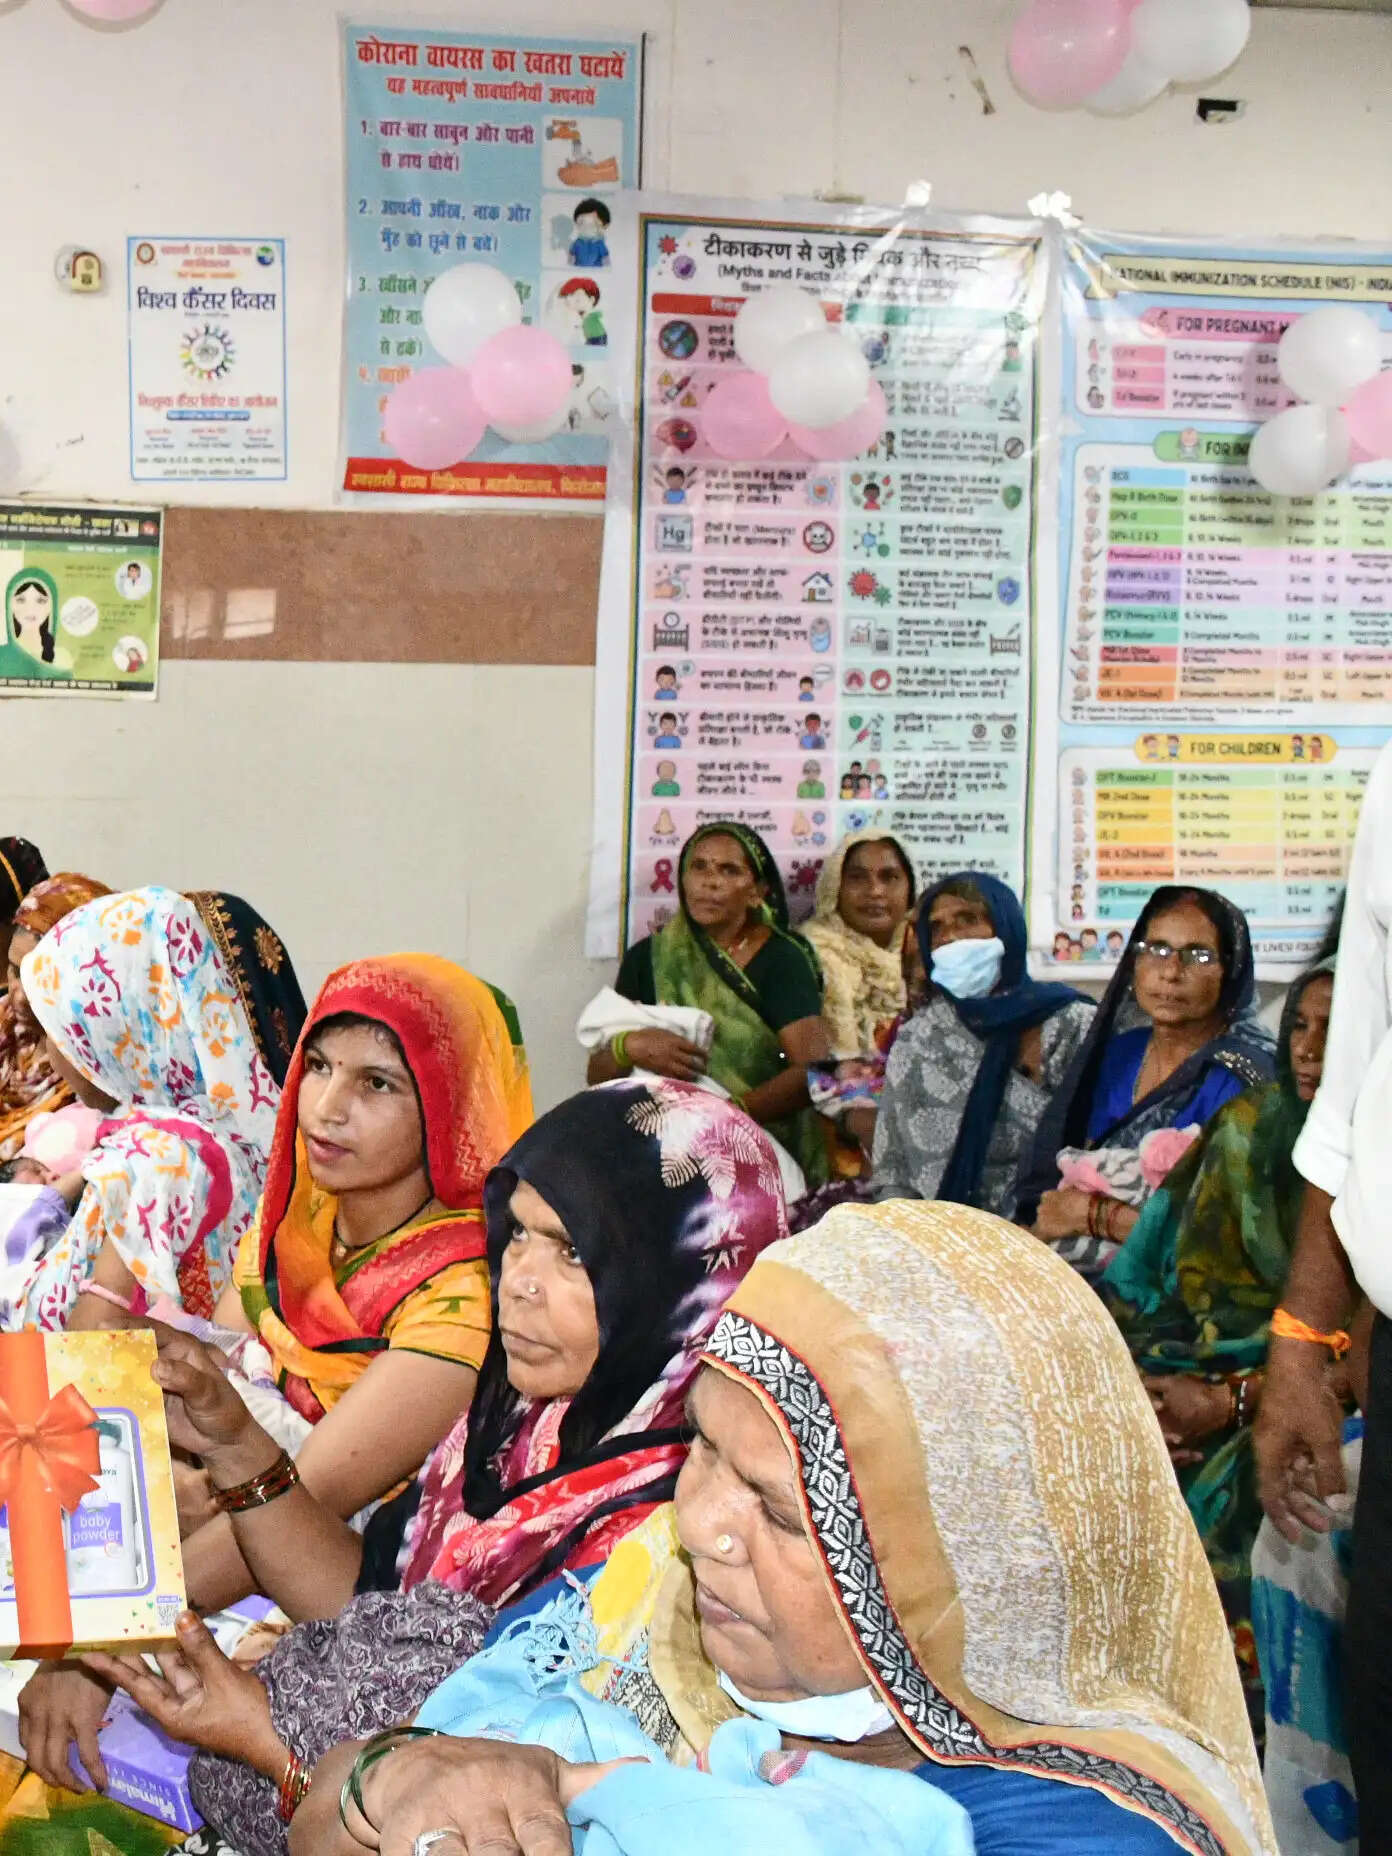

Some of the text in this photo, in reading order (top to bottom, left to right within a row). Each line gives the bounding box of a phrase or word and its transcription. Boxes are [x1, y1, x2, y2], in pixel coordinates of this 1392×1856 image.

[426, 45, 484, 71] वायरस
[492, 50, 516, 73] का
[524, 52, 572, 76] खतरा
[434, 123, 469, 145] साबुन
[475, 123, 500, 143] और
[505, 124, 536, 144] पानी
[507, 202, 531, 222] और
[703, 233, 791, 260] टीकाकरण
[796, 239, 810, 261] से
[817, 242, 846, 270] जुड़े
[718, 264, 831, 281] (Myths and Facts
[137, 286, 277, 310] विश्व कैंसर दिवस
[1177, 316, 1275, 335] FOR PREGNANT
[1205, 441, 1232, 455] FOR
[1190, 743, 1282, 756] FOR CHILDREN
[80, 1513, 112, 1529] baby
[72, 1528, 121, 1544] powder
